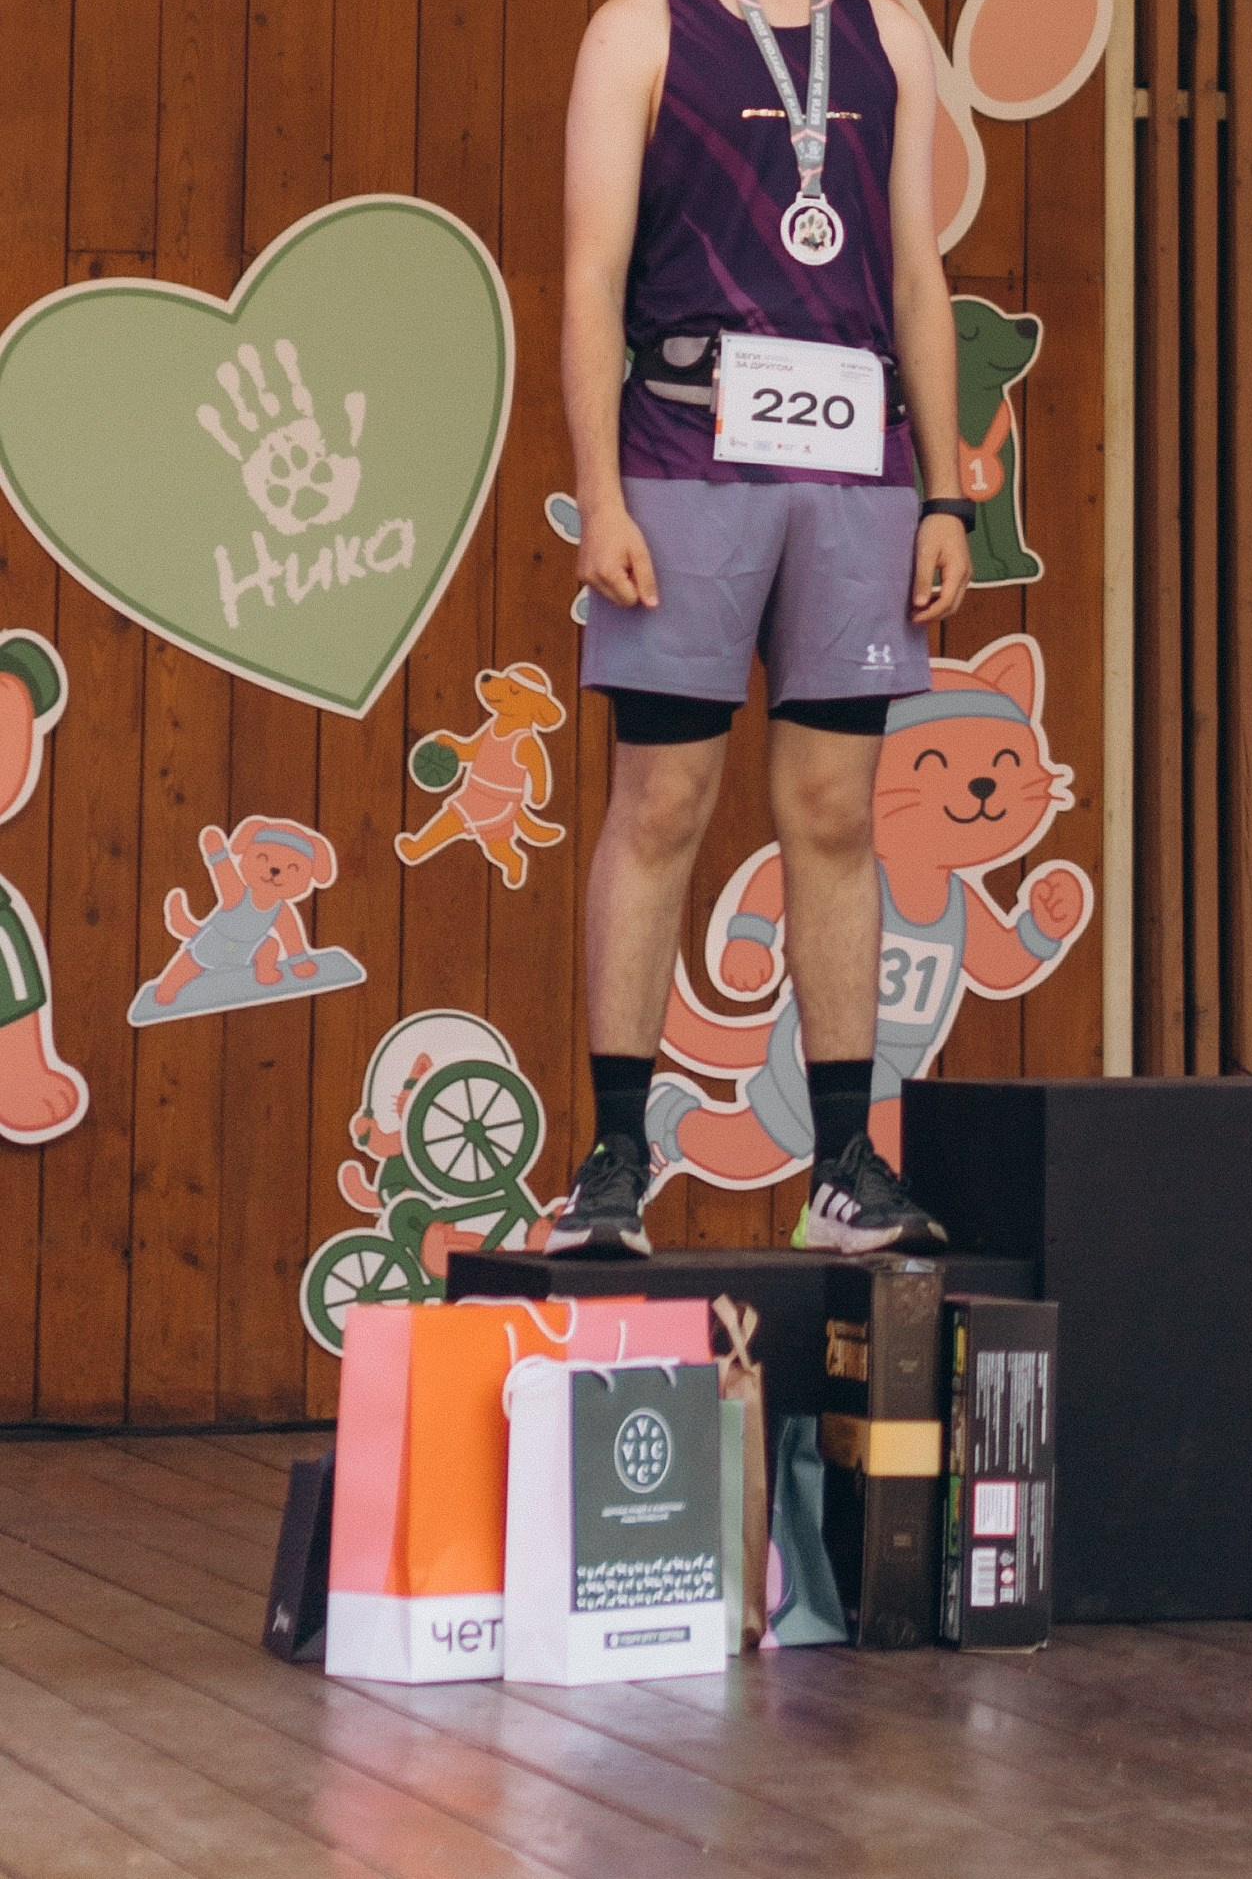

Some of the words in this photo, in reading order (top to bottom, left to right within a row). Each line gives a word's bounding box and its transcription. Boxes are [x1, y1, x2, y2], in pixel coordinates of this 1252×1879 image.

[811, 98, 821, 125] БЕГИ
[752, 387, 855, 430] 220
[969, 458, 988, 491] 1
[213, 518, 416, 629] Ника
[878, 947, 938, 1013] 31
